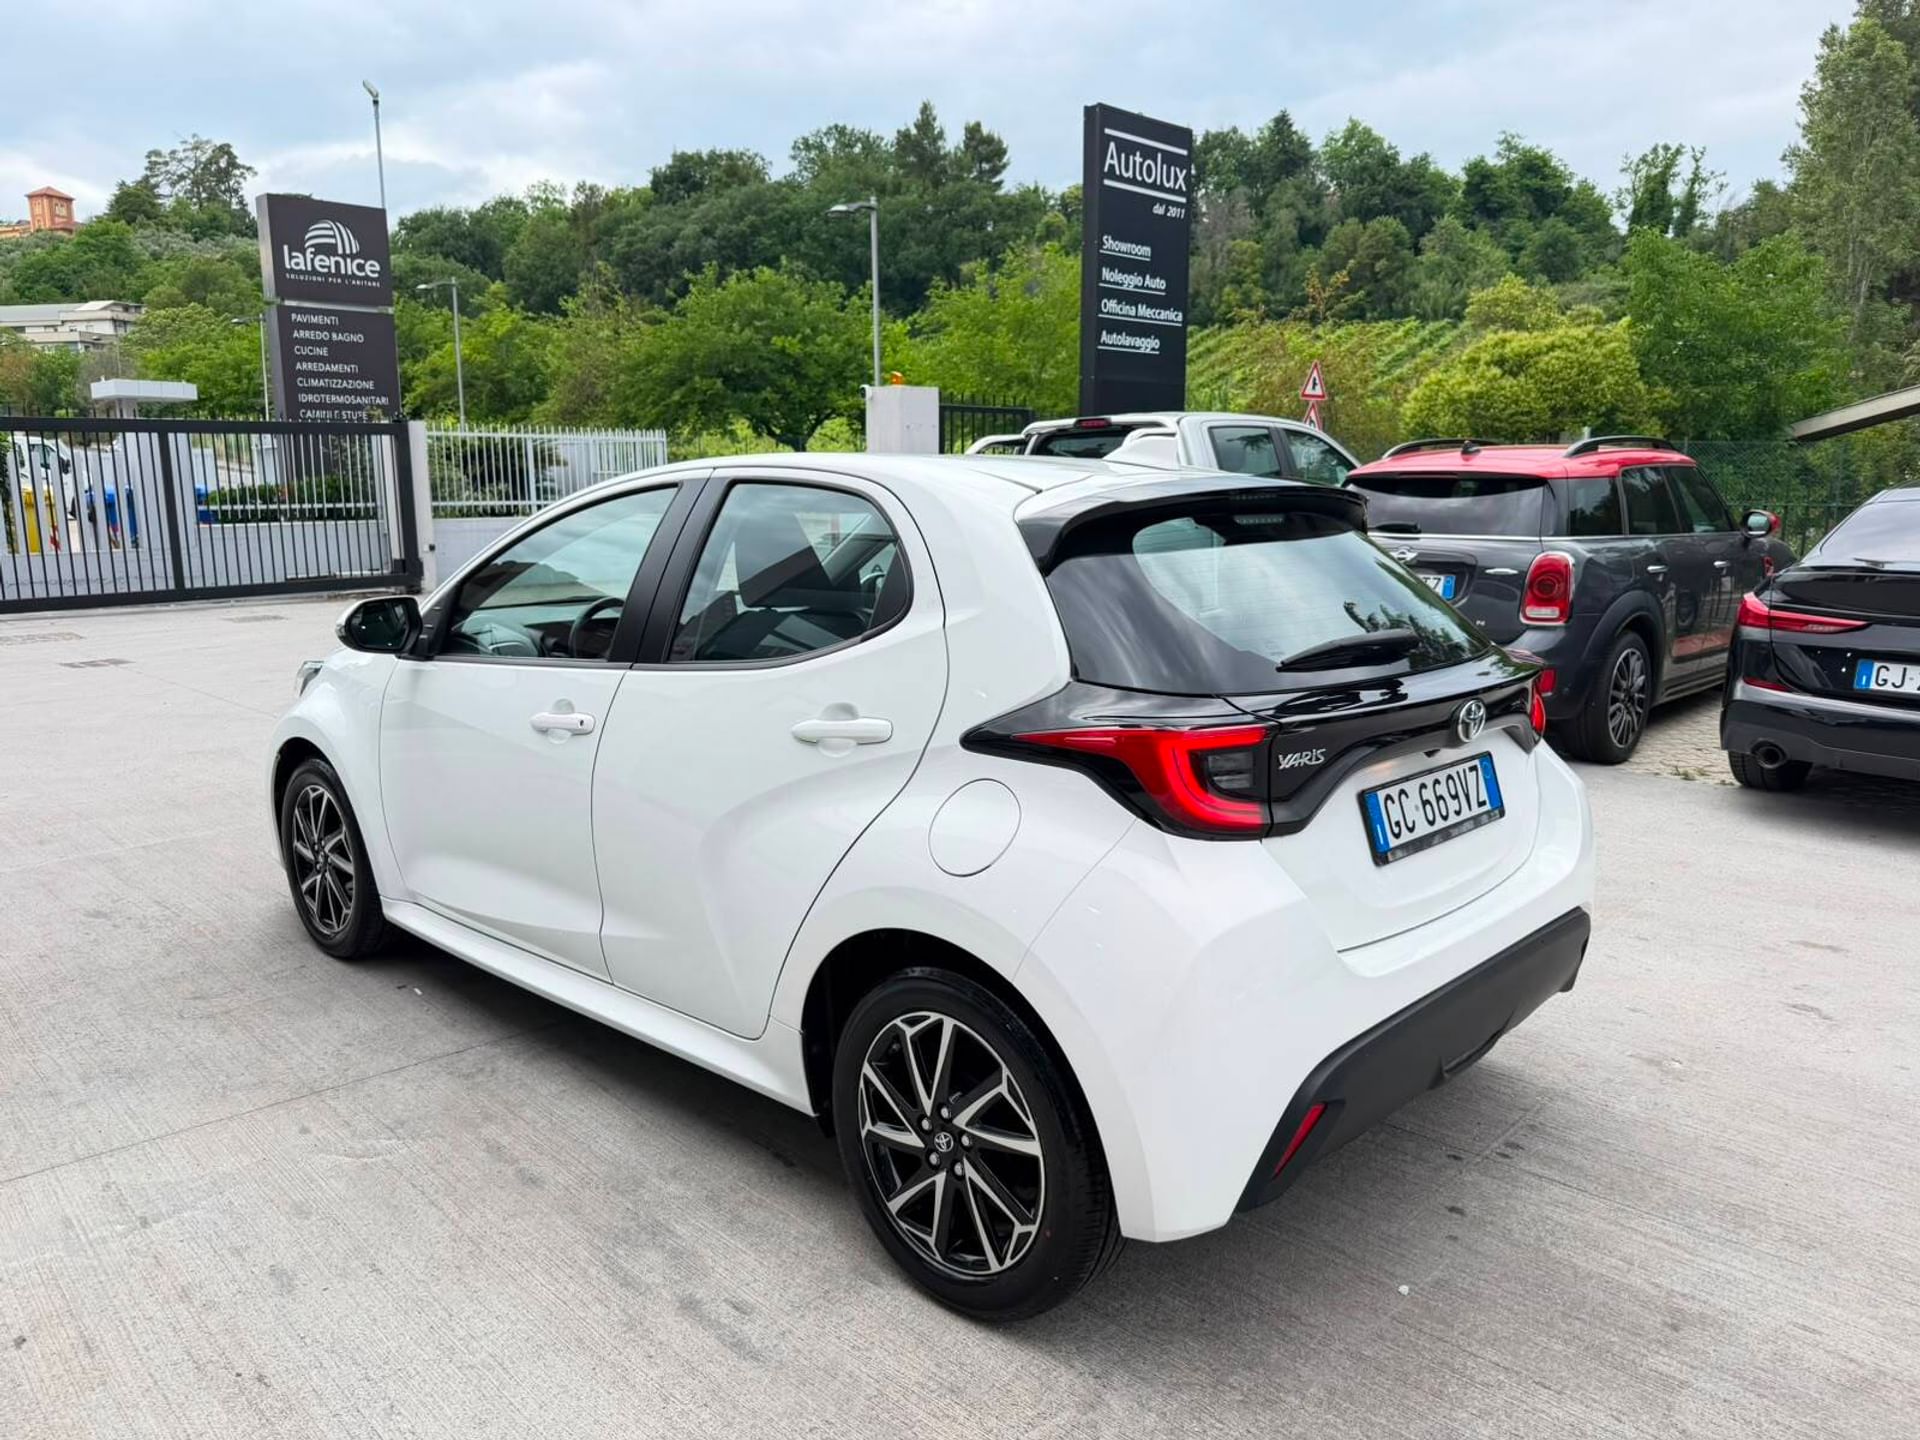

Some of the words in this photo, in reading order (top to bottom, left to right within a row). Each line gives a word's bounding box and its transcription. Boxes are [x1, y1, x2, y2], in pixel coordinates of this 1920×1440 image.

[1104, 141, 1187, 192] Autolux
[1152, 202, 1166, 216] dal
[1166, 205, 1186, 220] 2011
[1102, 235, 1152, 257] Showroom
[283, 244, 380, 277] lafenice
[1102, 266, 1144, 288] Noleggio
[1144, 274, 1167, 290] Auto
[291, 313, 339, 326] PAVIMENTI
[1101, 298, 1137, 317] Officina
[1137, 303, 1183, 322] Meccanica
[293, 330, 330, 341] ARREDO
[332, 332, 364, 343] BAGNO
[1100, 330, 1160, 351] Autolavaggio
[294, 345, 329, 356] CUCINE
[296, 361, 359, 374] ARREDAMENTI
[297, 377, 375, 390] CLIMATIZZAZIONE
[298, 393, 389, 405] IDROTERMOSANITARI
[1278, 748, 1327, 770] YARIS
[1418, 766, 1488, 827] 669VZ
